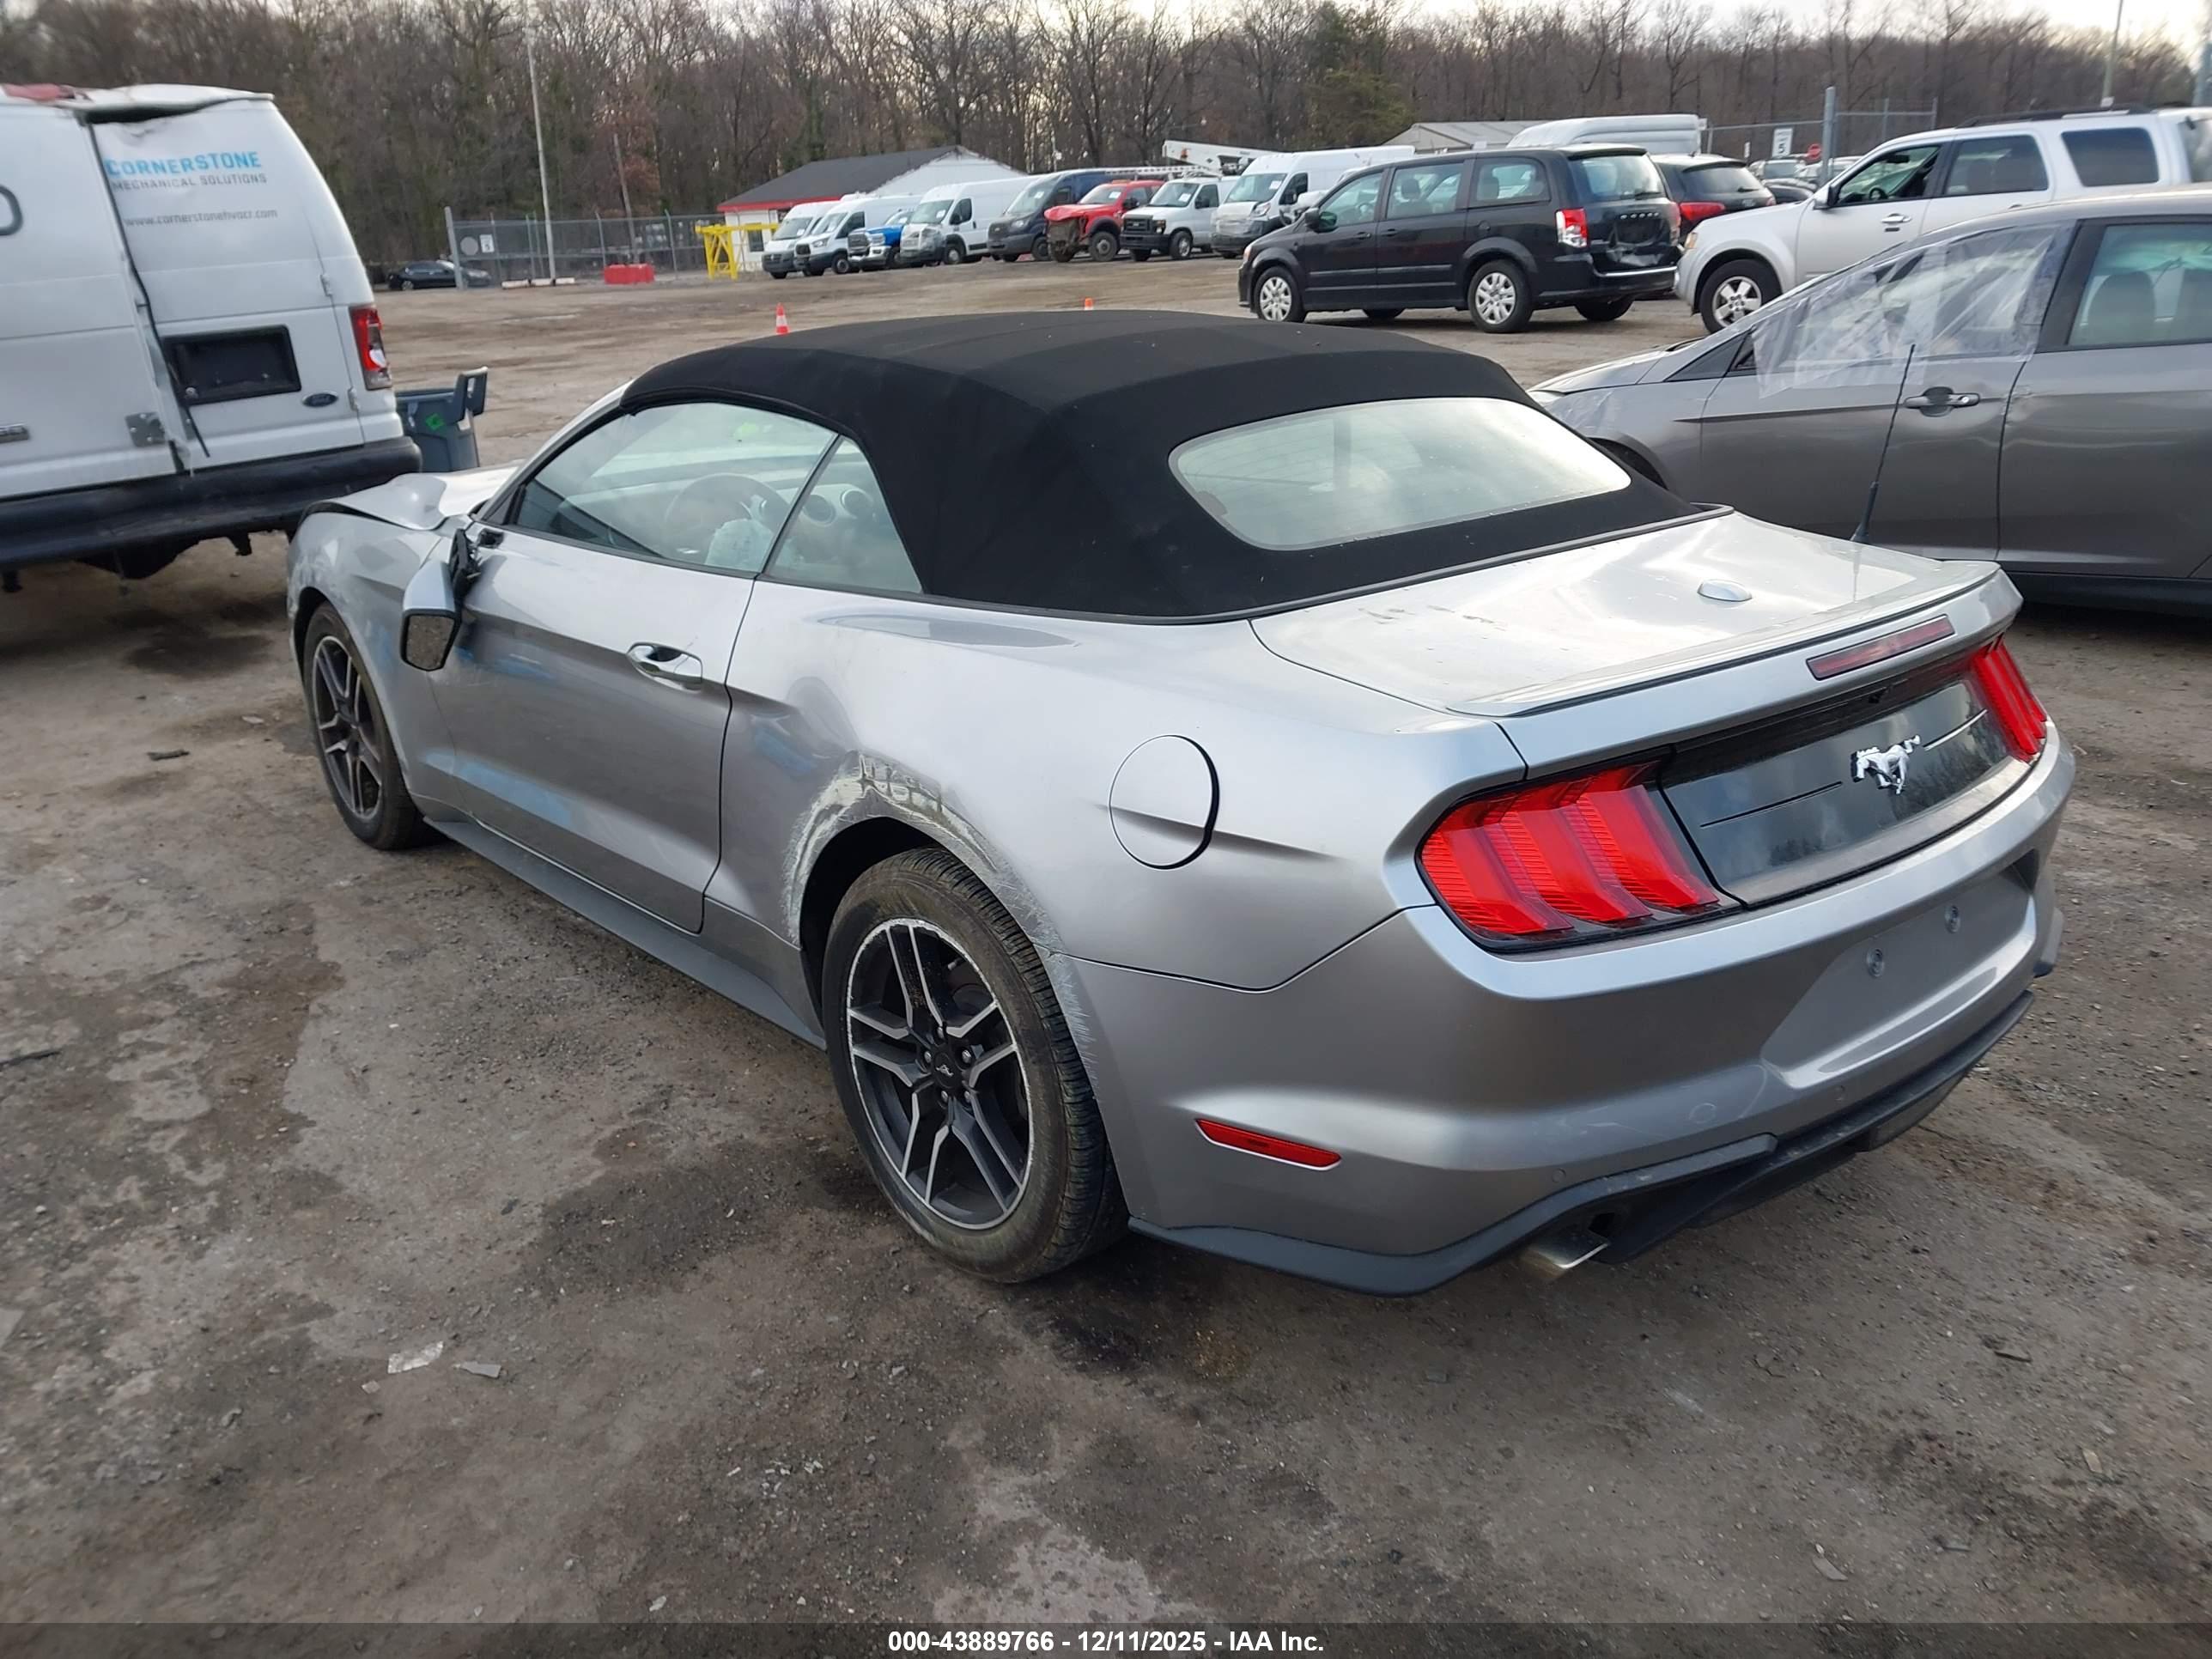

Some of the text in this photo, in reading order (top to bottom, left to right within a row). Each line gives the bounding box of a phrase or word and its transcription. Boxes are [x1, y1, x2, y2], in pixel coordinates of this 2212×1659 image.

[104, 151, 262, 176] CORNERSTONE
[112, 173, 267, 191] MECHANICAL SOLUTIONS
